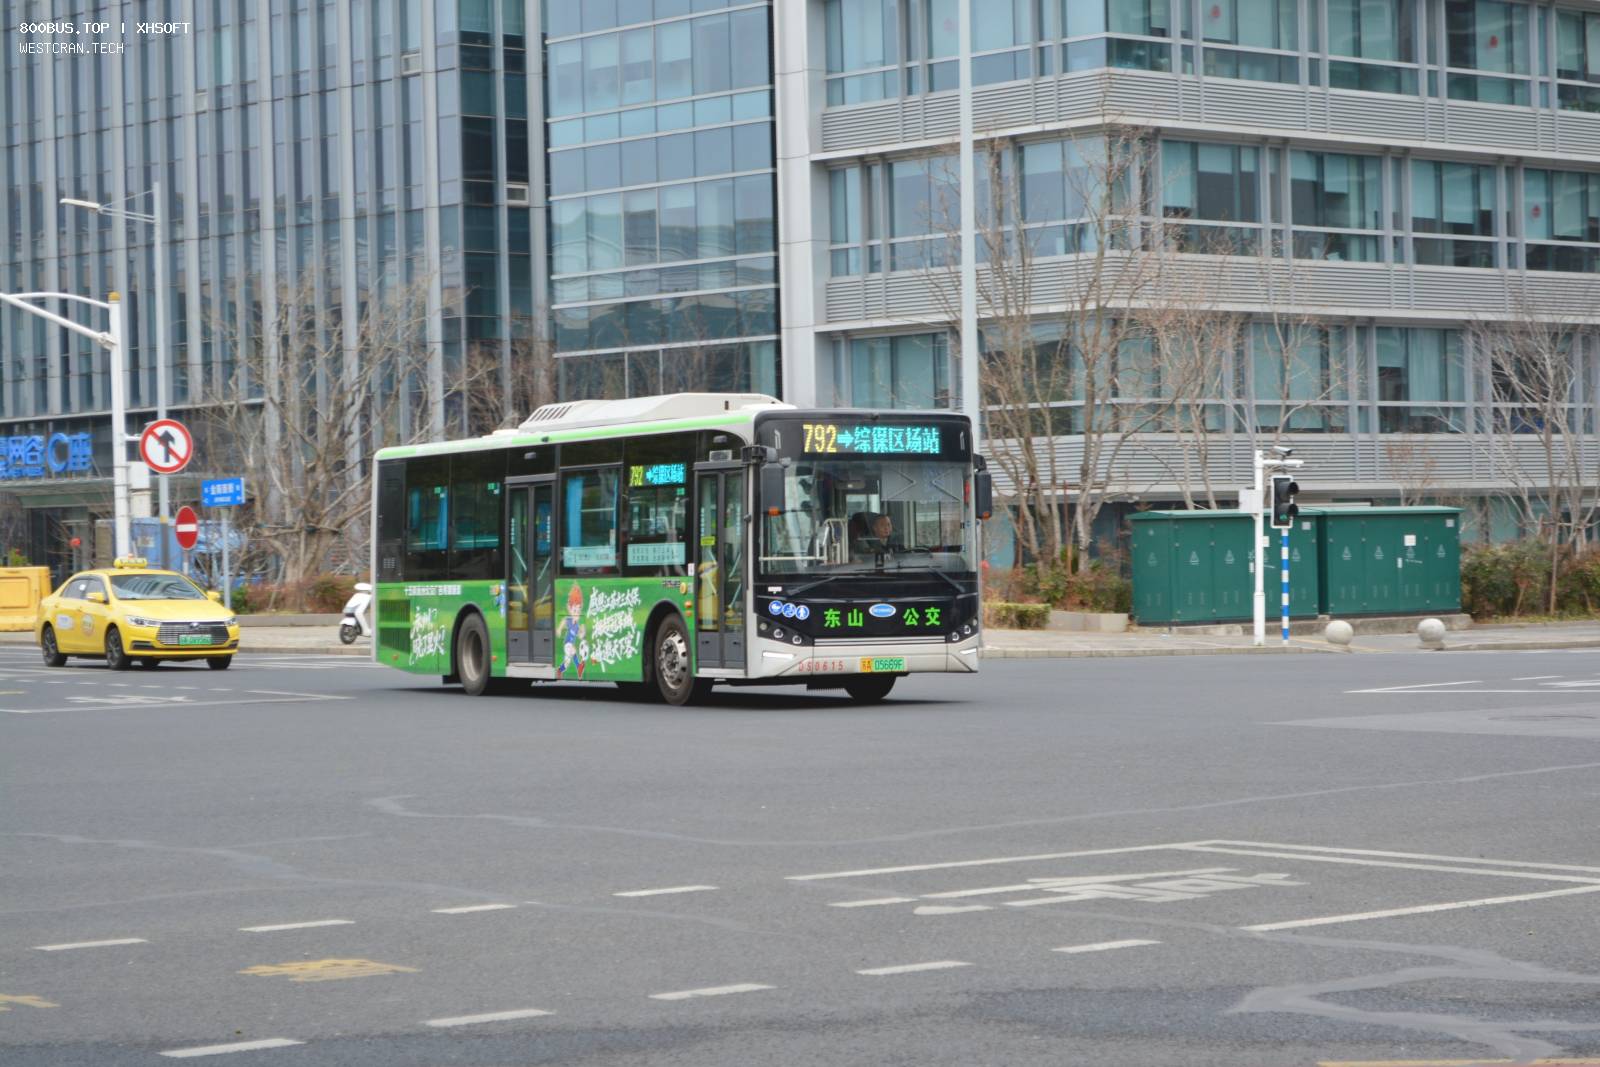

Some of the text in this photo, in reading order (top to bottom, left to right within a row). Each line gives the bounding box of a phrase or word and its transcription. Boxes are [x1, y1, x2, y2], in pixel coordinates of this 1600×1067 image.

[802, 424, 837, 453] 792
[629, 465, 644, 487] 792
[824, 608, 863, 628] 东山
[902, 607, 941, 626] 公交
